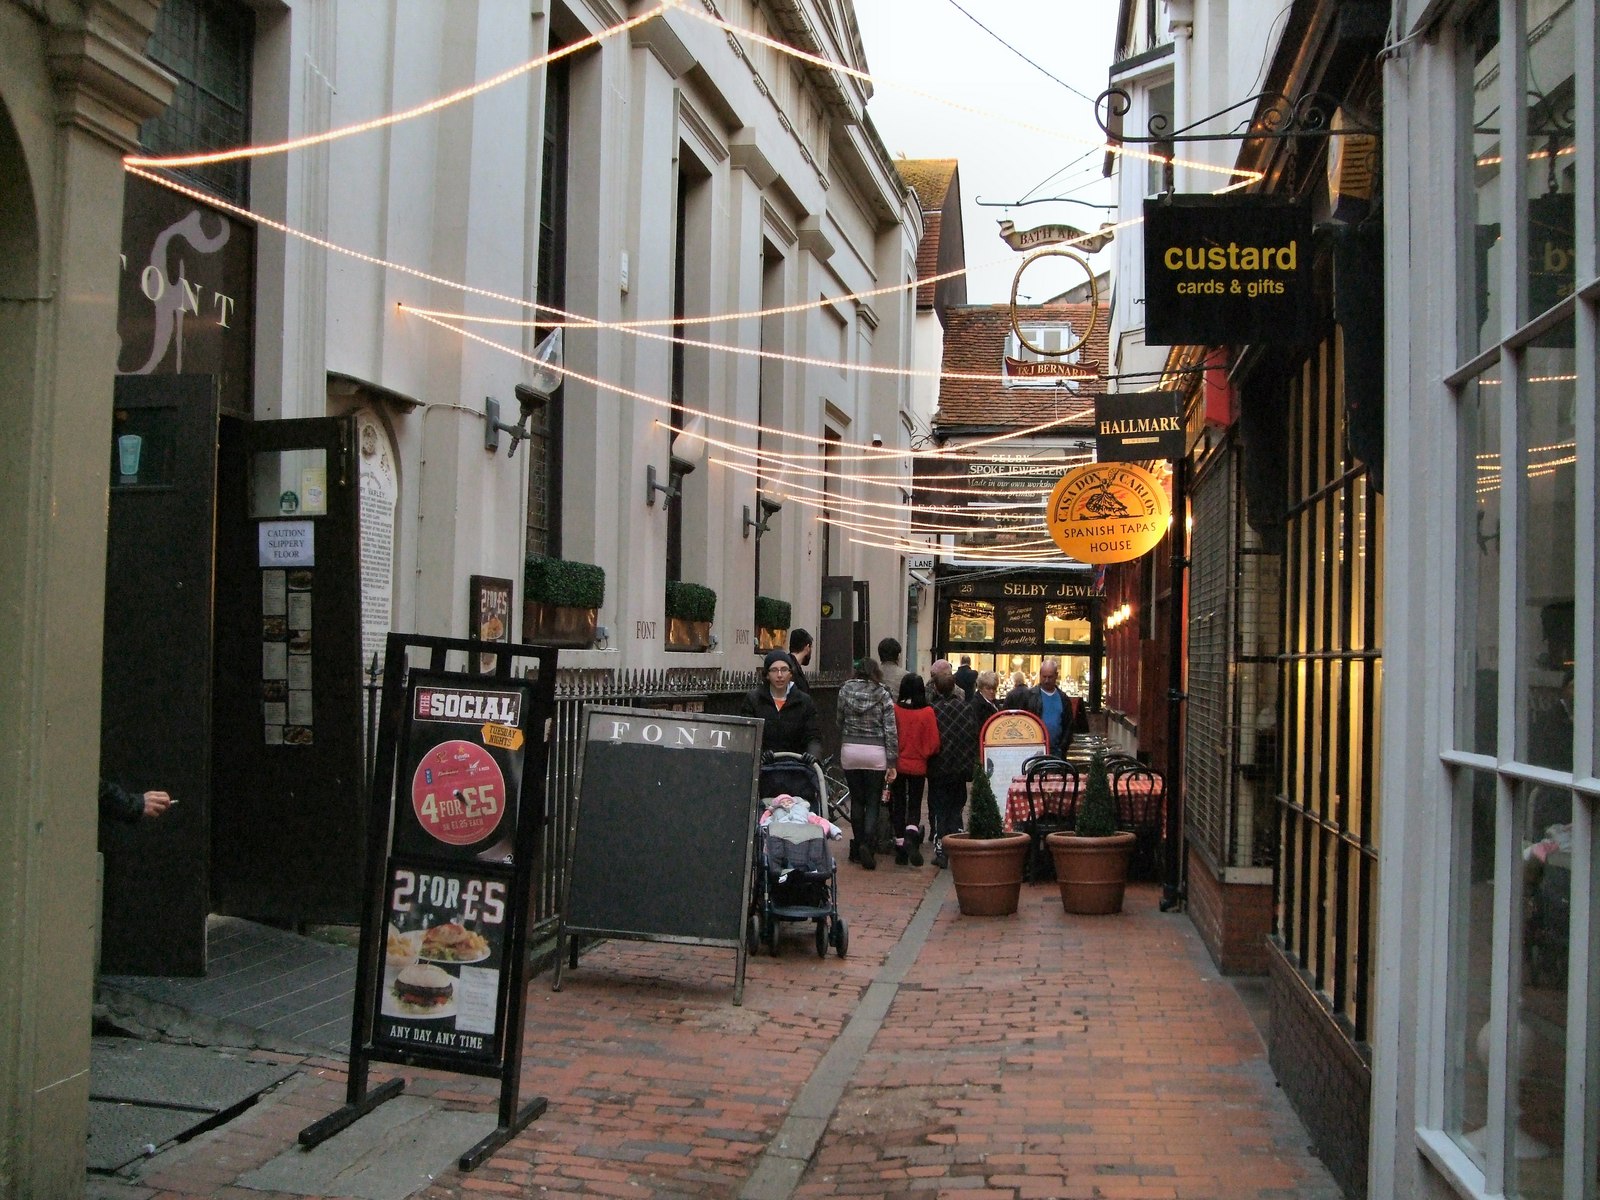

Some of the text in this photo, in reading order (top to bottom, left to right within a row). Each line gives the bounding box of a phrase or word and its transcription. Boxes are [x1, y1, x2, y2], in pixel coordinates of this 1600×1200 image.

[1020, 227, 1054, 245] BATH
[1164, 240, 1297, 270] custard
[119, 253, 234, 329] ONT
[1176, 279, 1285, 297] cards & gifts
[1016, 364, 1087, 376] T&J BERNARD
[1100, 416, 1181, 435] HALLMARK
[991, 454, 1029, 463] SELBY
[969, 465, 1068, 476] SPOKE JEWELLERY
[1058, 472, 1155, 522] CASA DON CARLOS
[267, 529, 306, 538] CAUTION!
[1064, 522, 1156, 538] SPANISH TAPAS
[268, 540, 304, 548] SLIPPERY
[1090, 540, 1132, 552] HOUSE
[274, 550, 300, 559] FLOOR
[961, 584, 973, 593] 25
[1004, 582, 1048, 596] SELBY
[636, 621, 656, 640] FONT
[735, 629, 749, 645] FONT
[419, 693, 515, 724] THE SOCIAL
[489, 725, 517, 739] TUESDAY
[609, 721, 731, 749] FONT
[488, 734, 513, 747] NIGHTS
[421, 785, 498, 823] 4 FOR £5
[392, 870, 506, 924] 2 FOR £5
[390, 1025, 410, 1039] ANY
[435, 1032, 456, 1046] ANY
[459, 1035, 483, 1050] TIME
